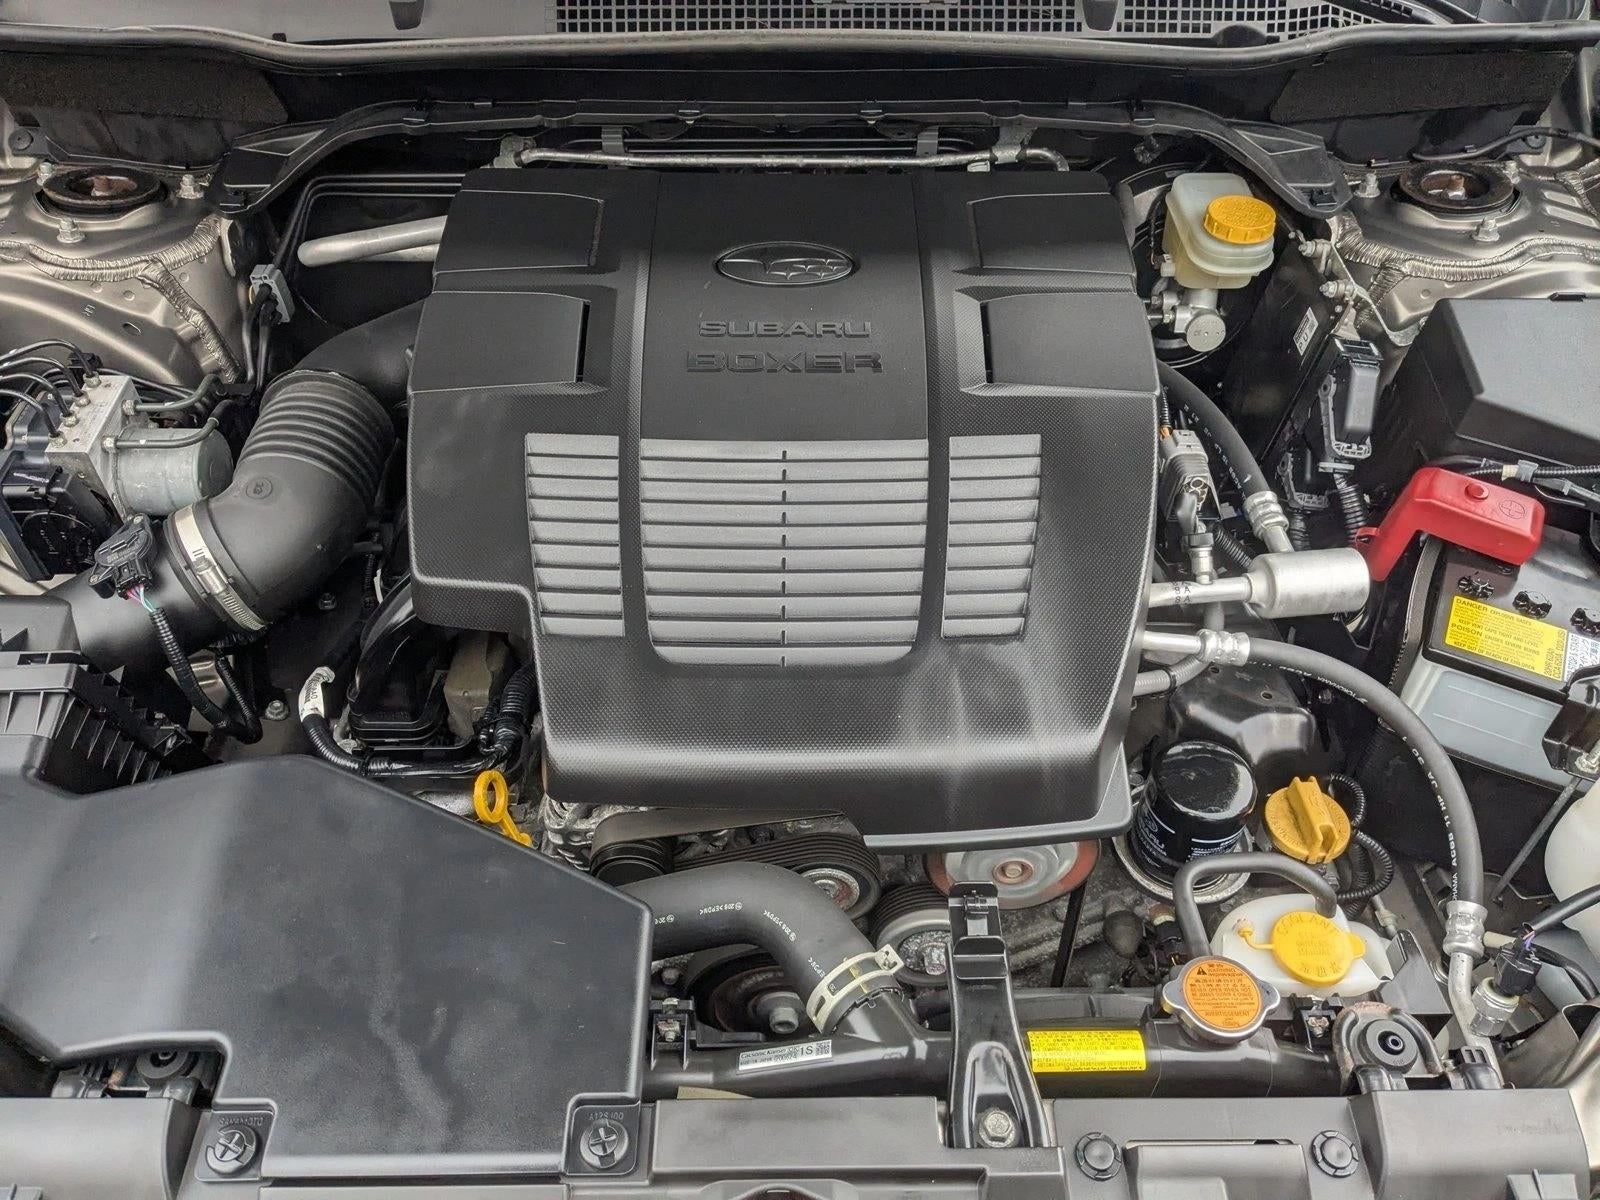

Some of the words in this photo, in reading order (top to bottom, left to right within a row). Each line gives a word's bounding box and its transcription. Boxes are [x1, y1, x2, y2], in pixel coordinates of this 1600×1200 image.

[699, 320, 871, 338] SUBARU
[686, 351, 884, 373] BOXER
[1455, 598, 1488, 612] DANGER
[1450, 622, 1483, 637] POISON
